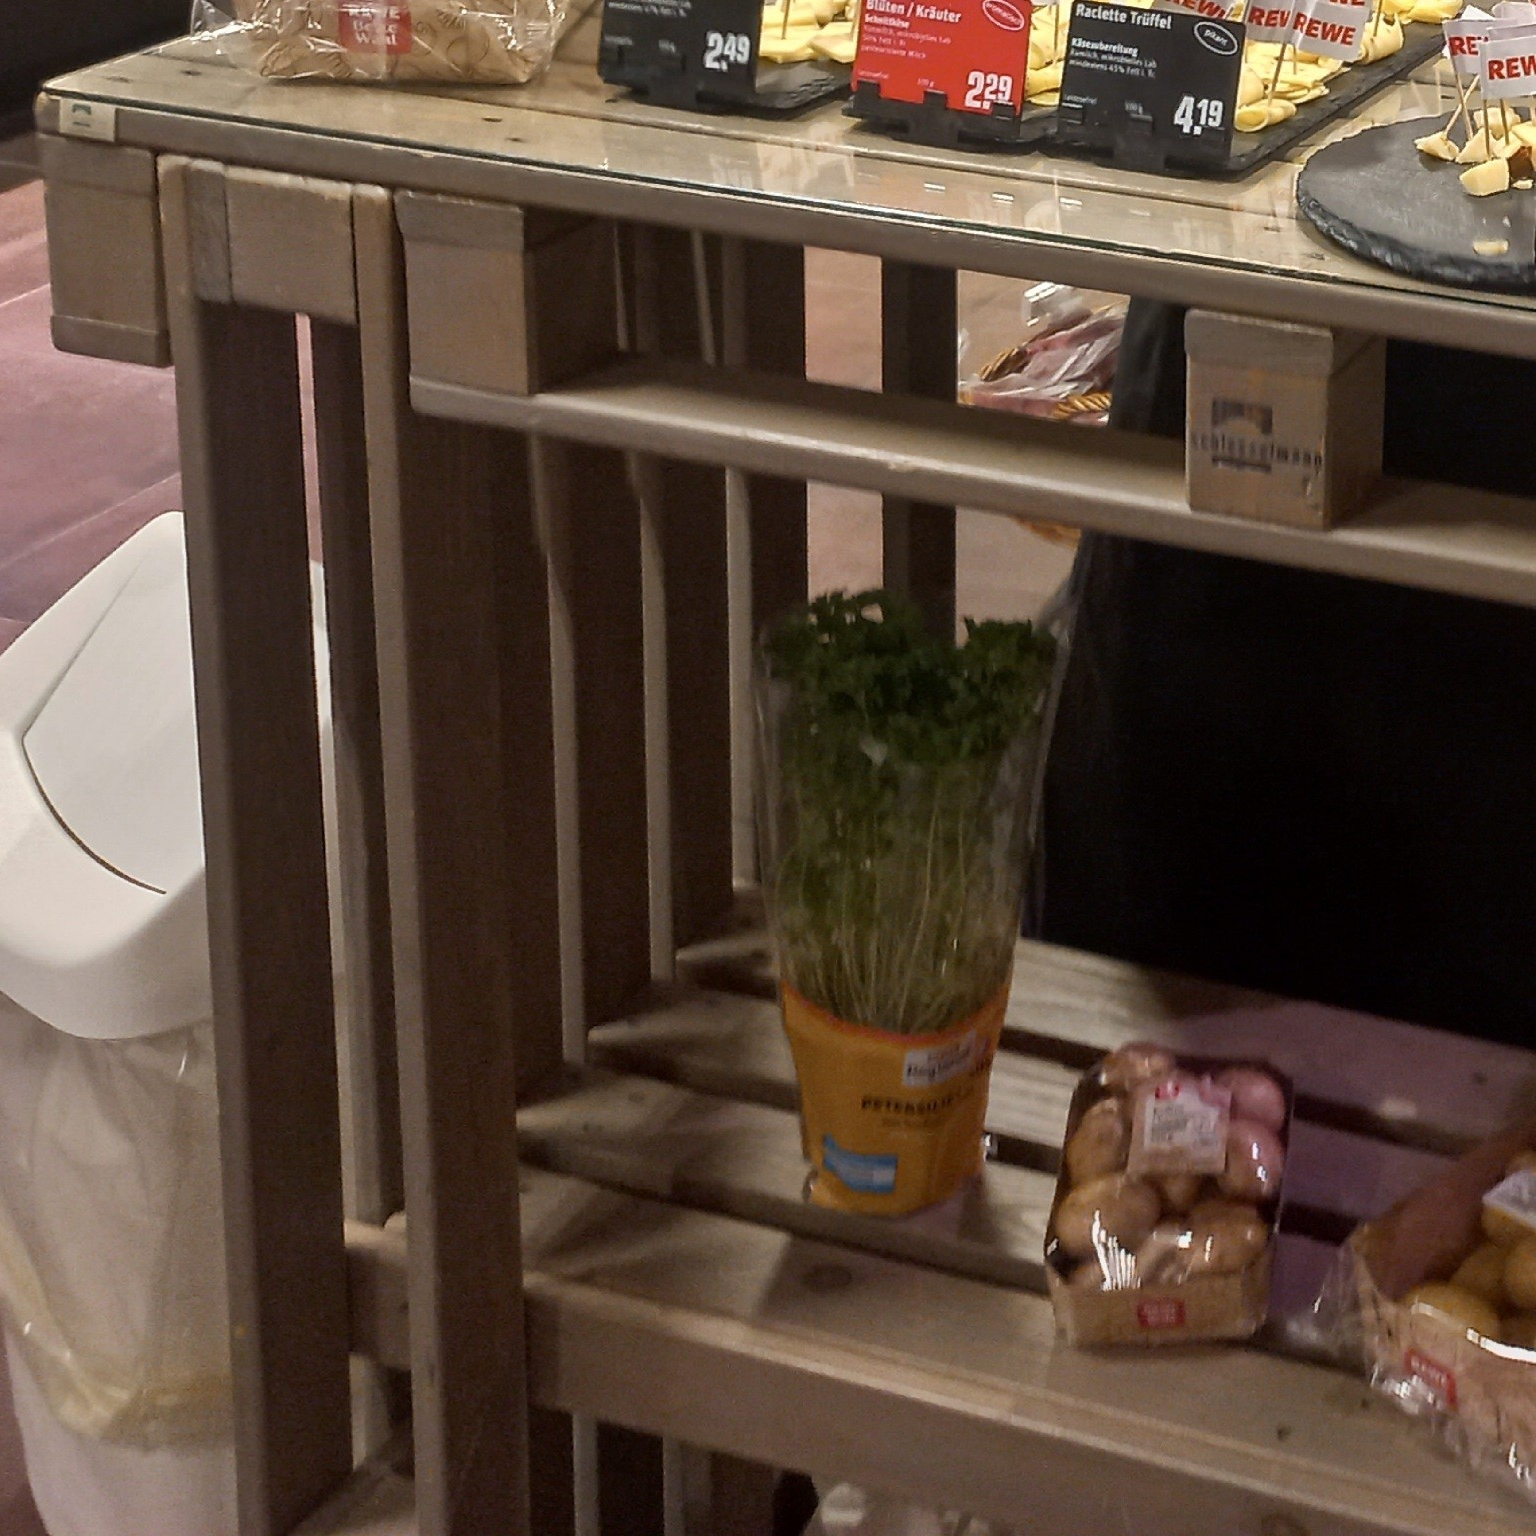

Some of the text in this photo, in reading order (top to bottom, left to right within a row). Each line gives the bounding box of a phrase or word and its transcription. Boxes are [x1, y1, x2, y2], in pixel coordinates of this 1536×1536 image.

[906, 2, 914, 18] /
[916, 4, 962, 23] Kräuter
[1075, 3, 1172, 30] Raclette Trüffel
[1293, 11, 1357, 46] REWE
